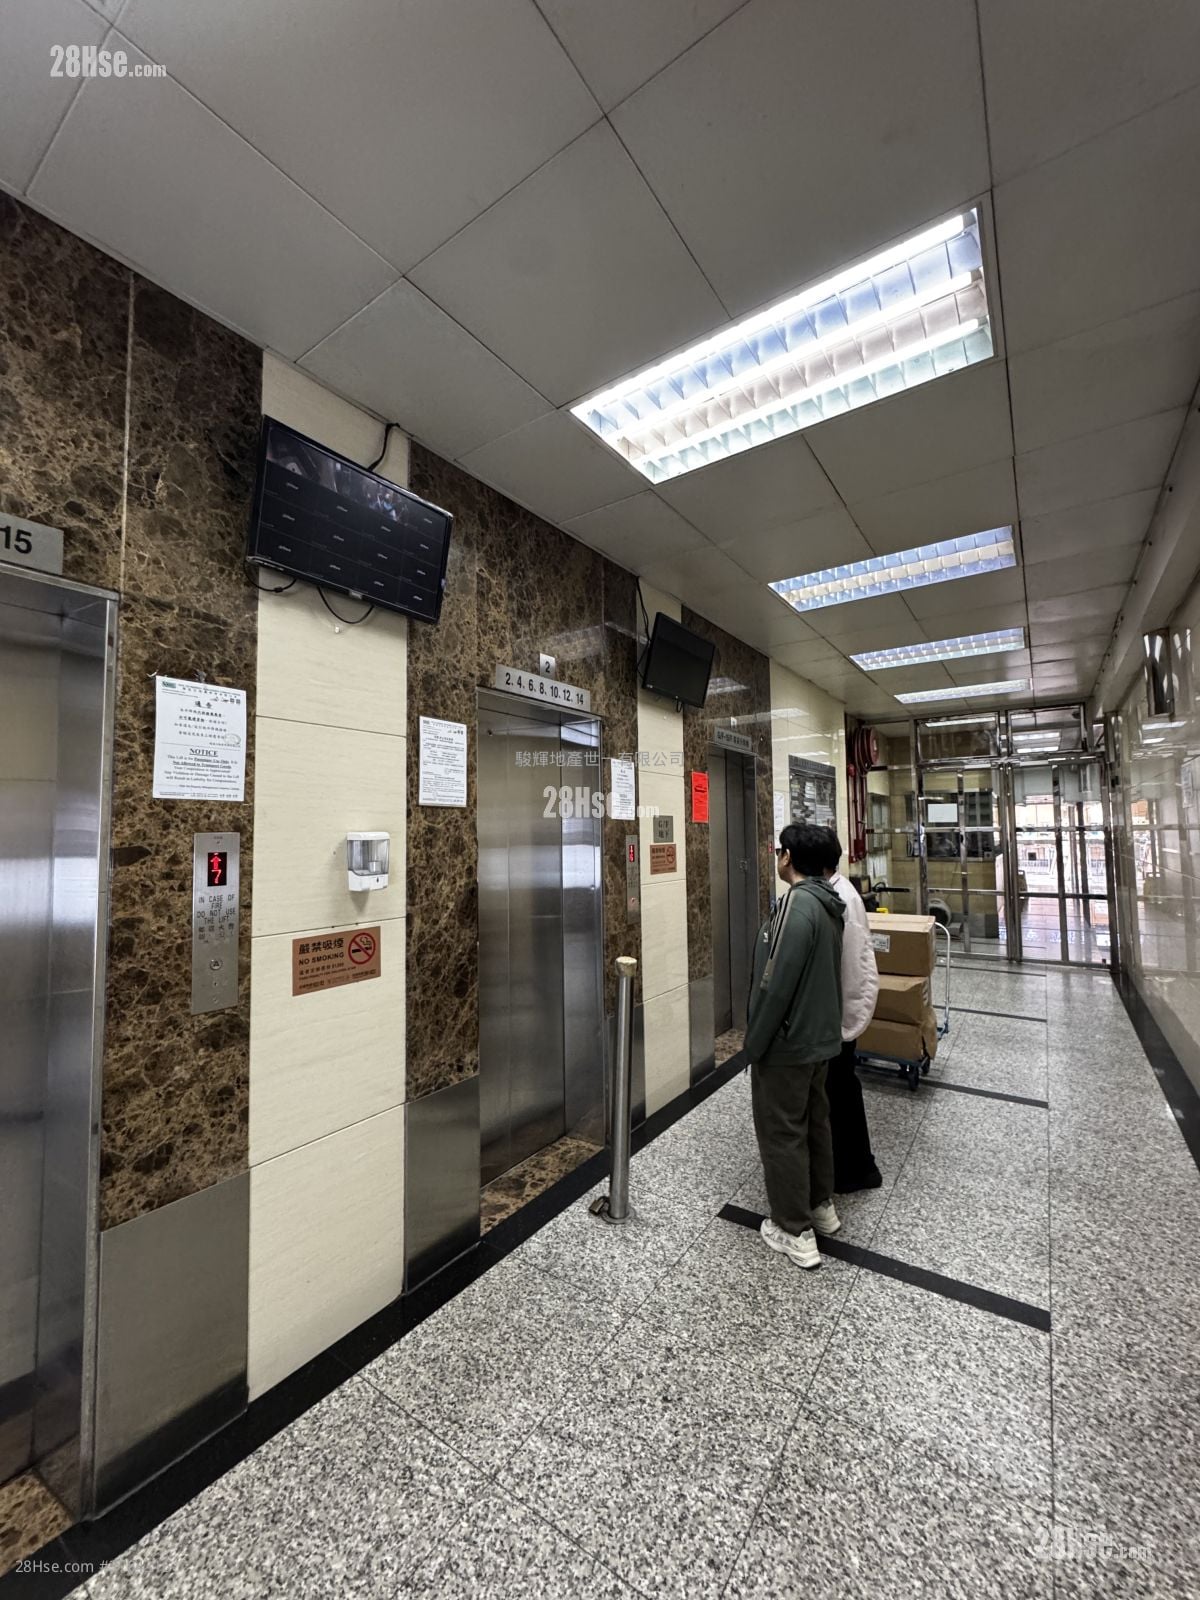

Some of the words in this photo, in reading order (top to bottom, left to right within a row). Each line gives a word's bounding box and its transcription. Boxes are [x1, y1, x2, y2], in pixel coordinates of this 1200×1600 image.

[0, 525, 32, 554] 15
[545, 661, 551, 674] 2
[576, 693, 584, 705] 14
[189, 748, 219, 757] NOTICE
[211, 869, 222, 884] 7
[198, 896, 205, 904] IN
[208, 894, 224, 903] CASE
[227, 893, 235, 901] OF
[211, 902, 223, 910] FIRE
[210, 909, 221, 917] NOT
[204, 917, 214, 925] THE
[298, 937, 345, 955] 嚴禁吸煙
[298, 958, 310, 966] NO
[311, 952, 345, 964] SMOKING
